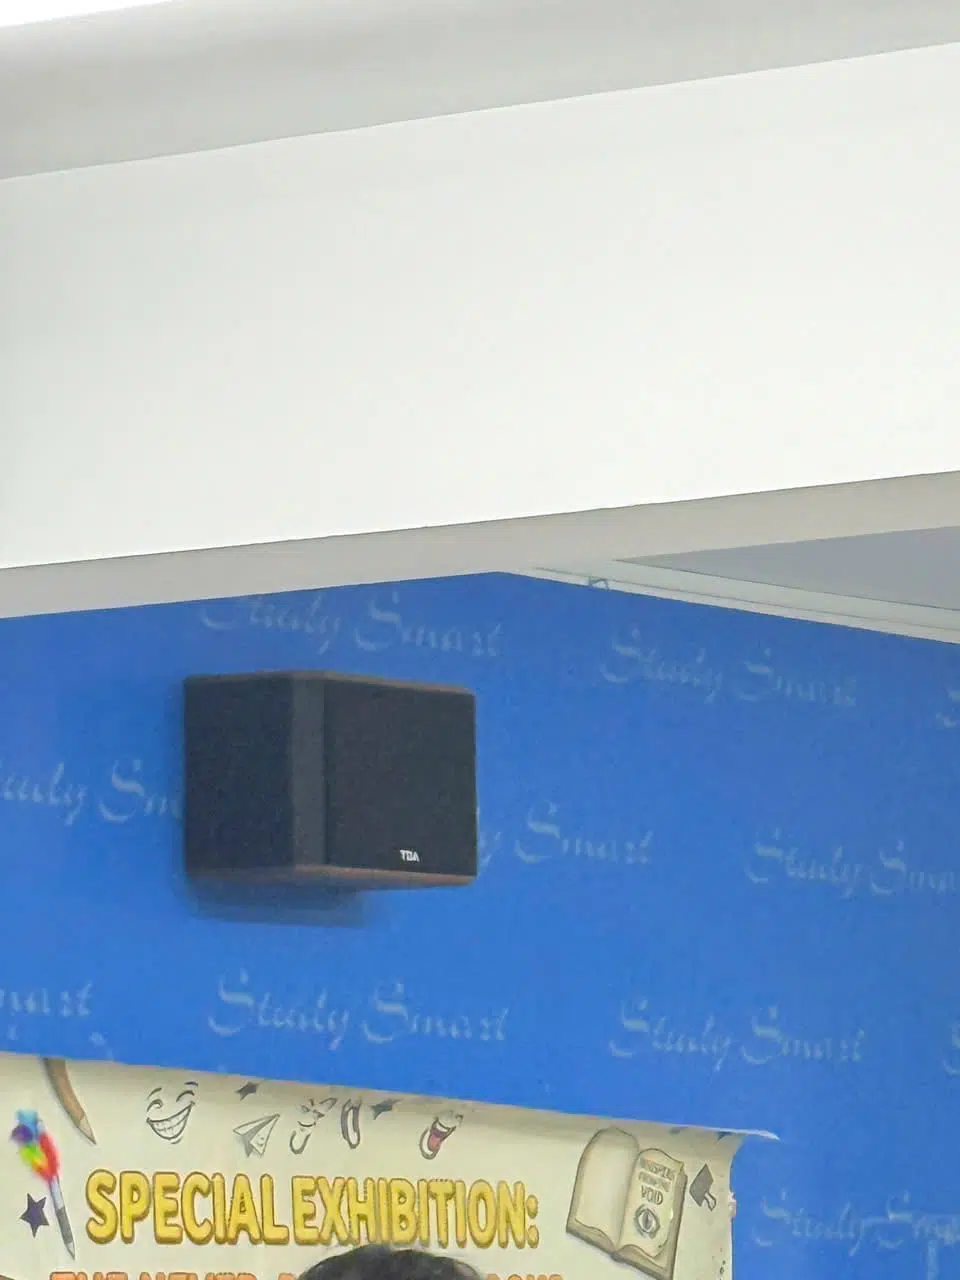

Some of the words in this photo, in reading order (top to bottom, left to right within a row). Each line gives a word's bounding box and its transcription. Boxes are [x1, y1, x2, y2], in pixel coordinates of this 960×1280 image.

[0, 760, 88, 827] tudy
[515, 801, 654, 865] Smart
[208, 968, 350, 1050] Study
[361, 981, 513, 1044] Smart
[609, 999, 731, 1072] Study
[740, 1005, 865, 1066] Smart
[85, 1168, 290, 1245] SPECIAL
[291, 1175, 540, 1249] EXHIBITION:
